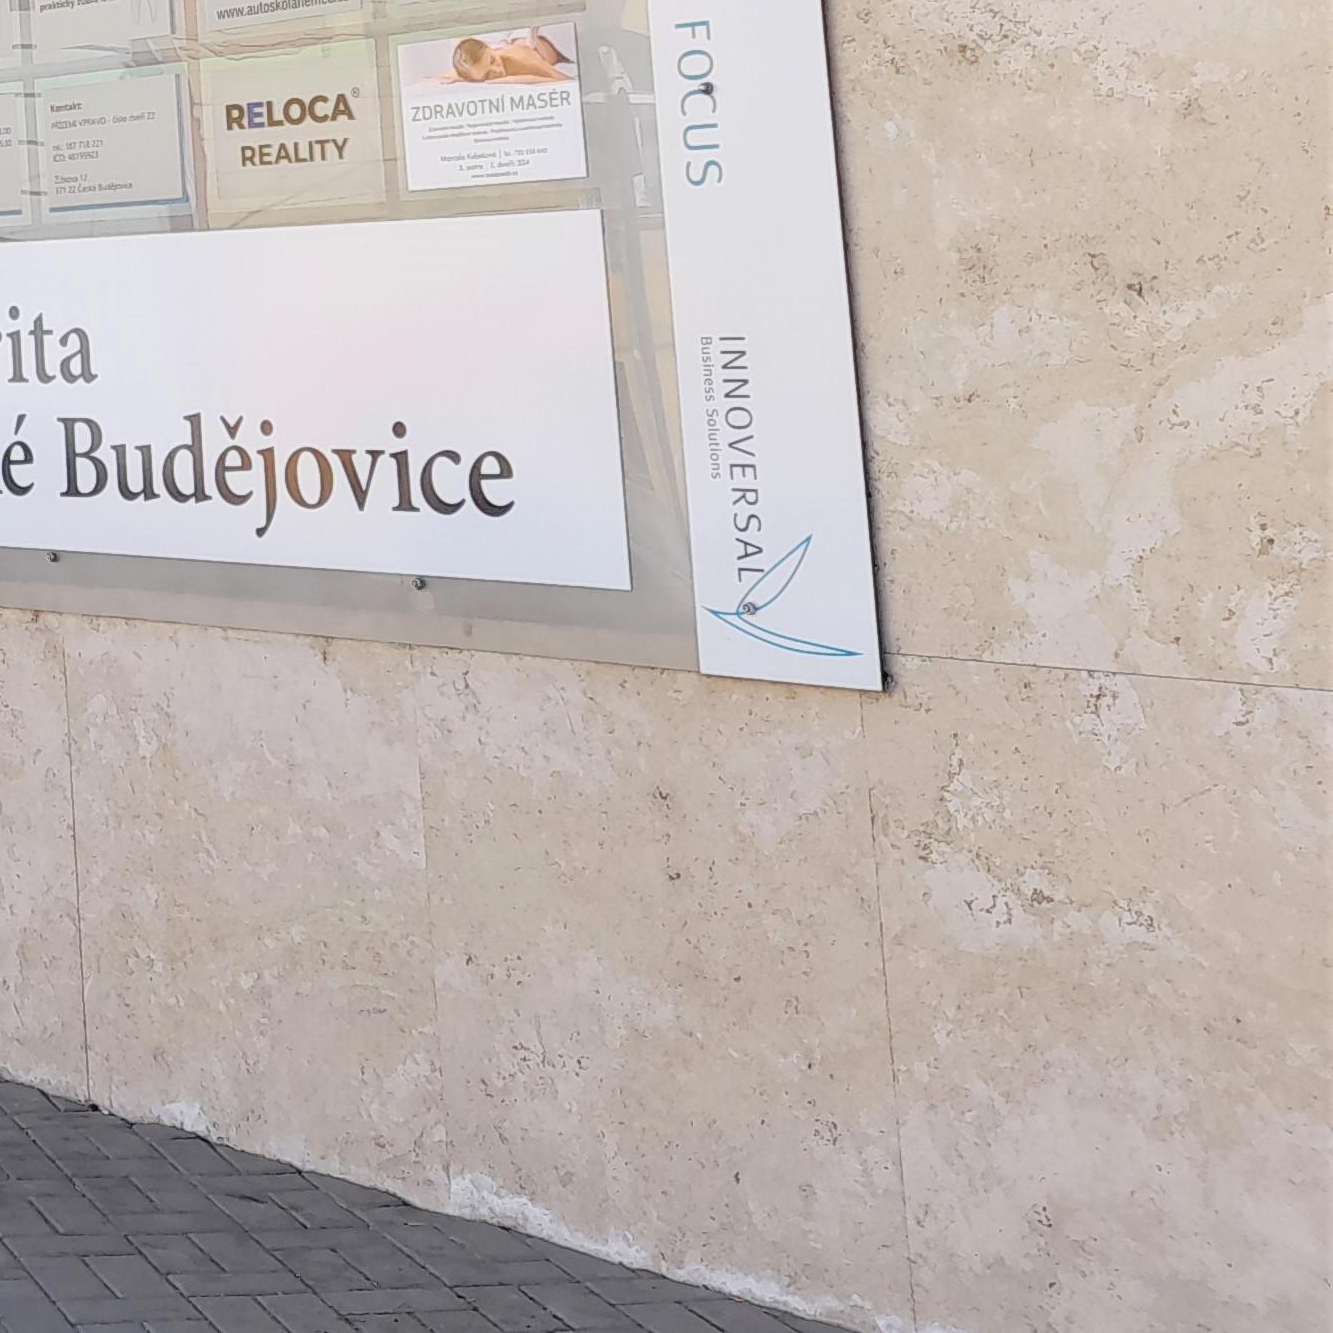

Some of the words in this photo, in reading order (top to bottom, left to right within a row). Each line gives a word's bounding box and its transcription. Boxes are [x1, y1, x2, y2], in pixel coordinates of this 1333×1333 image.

[411, 94, 506, 122] ZDRAVOTNÍ
[510, 88, 572, 112] MASÉR
[674, 21, 723, 186] FOCUS
[240, 137, 350, 167] REALITY
[700, 336, 715, 402] Business
[59, 411, 516, 539] Budějovice
[706, 409, 721, 480] Solutions
[719, 336, 765, 583] INNOVERSAL
